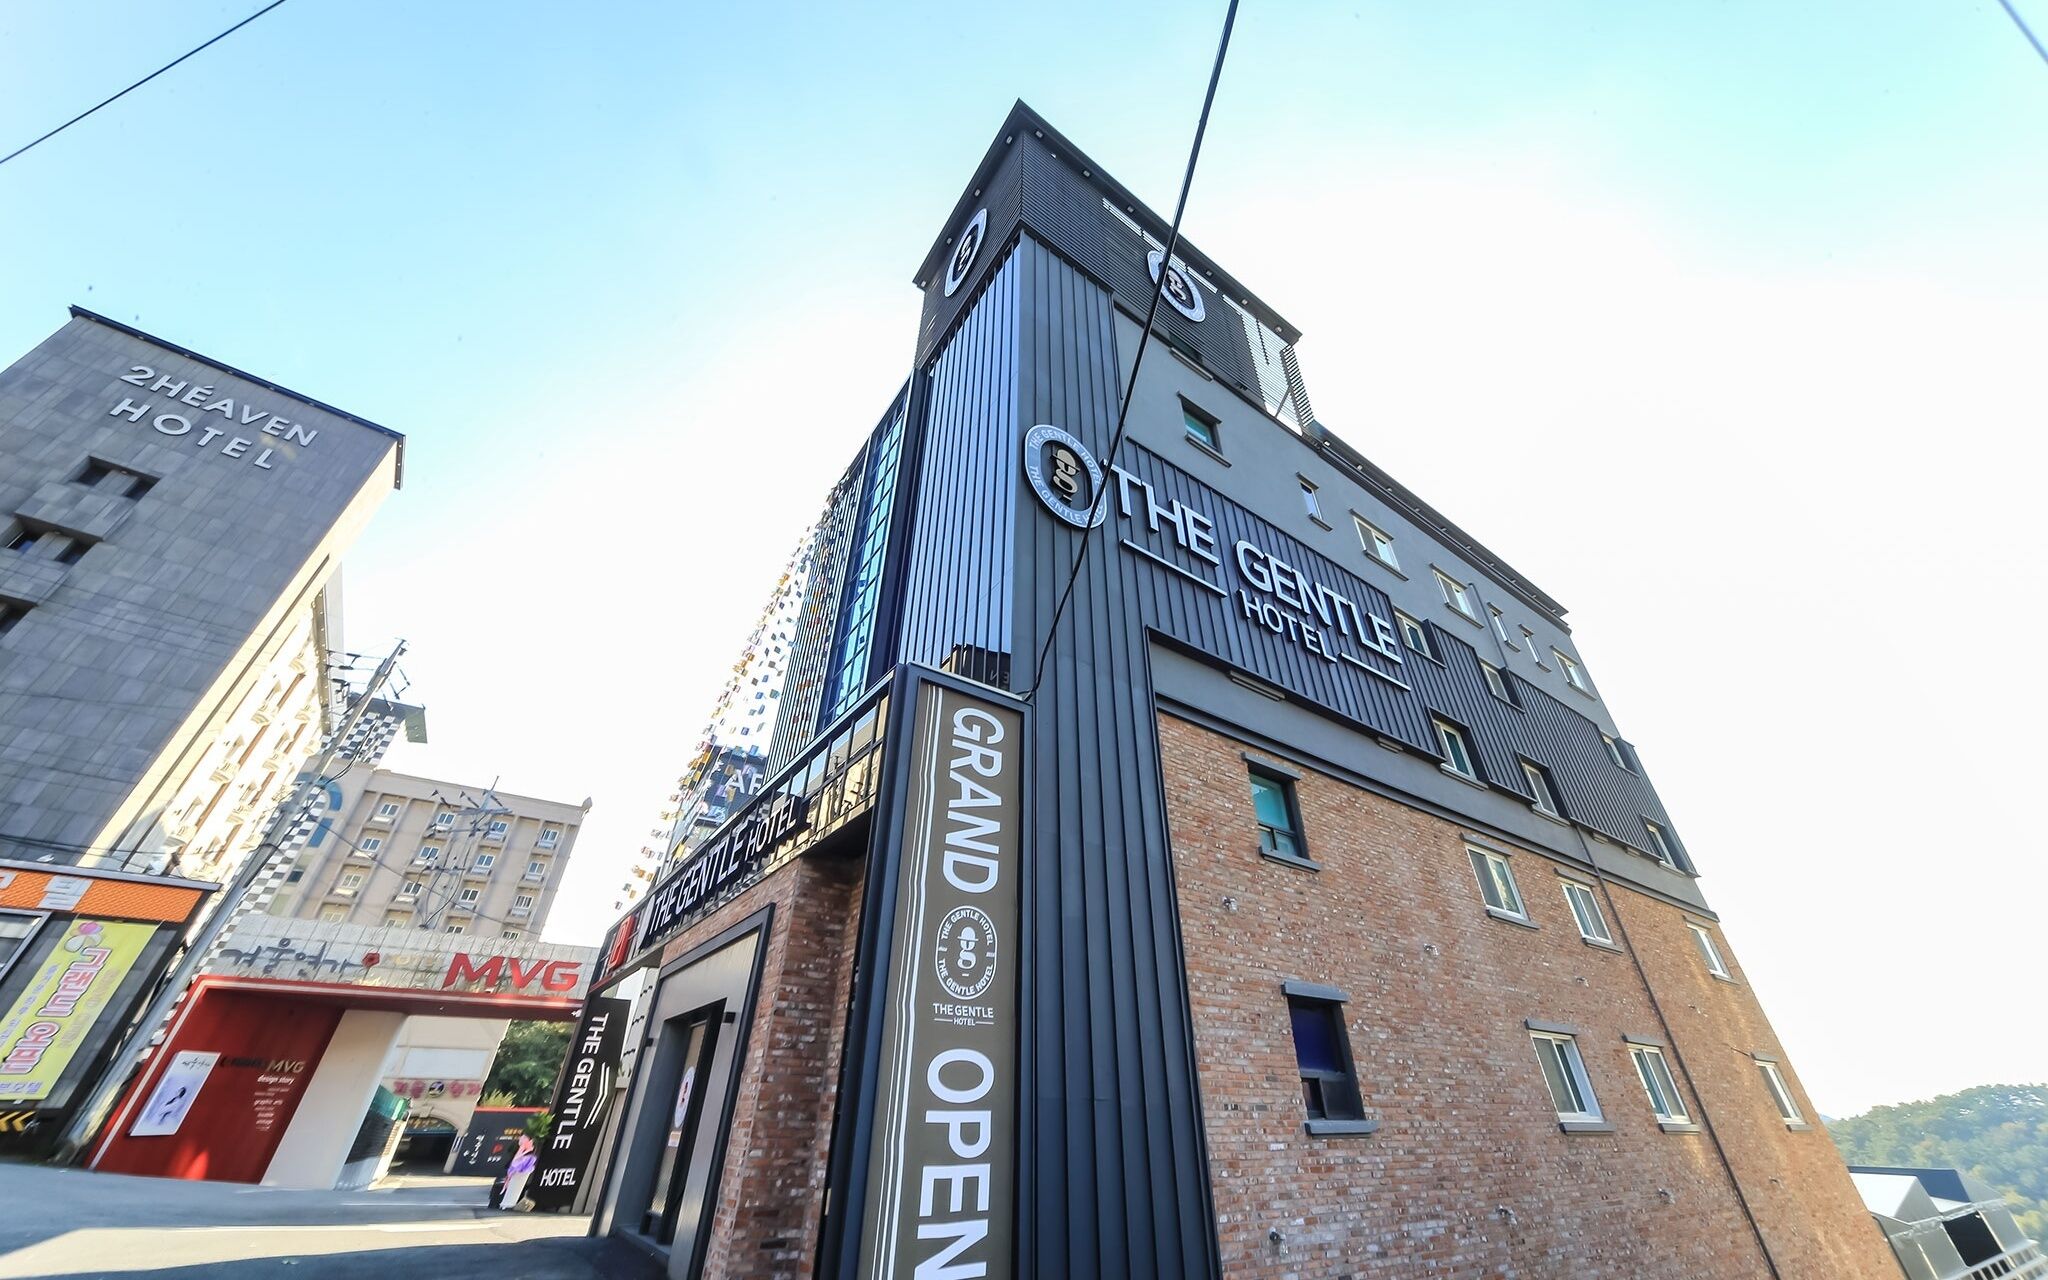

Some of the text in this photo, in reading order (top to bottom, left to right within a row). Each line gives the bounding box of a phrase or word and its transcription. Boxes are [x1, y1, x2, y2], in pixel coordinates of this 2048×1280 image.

[109, 398, 274, 470] HOTEL
[119, 365, 319, 447] 2HÉAVEN
[1029, 431, 1044, 450] THE
[1042, 429, 1080, 452] GENTLE
[1029, 466, 1104, 524] THE GENTLE HTEL
[1102, 459, 1403, 665] THE GENTLE
[1238, 588, 1338, 663] HOTEL
[943, 707, 1005, 894] GRAND
[649, 796, 796, 935] THE GENTLE HOTEL
[941, 909, 994, 946] THE GENTLE HOTEL
[36, 948, 112, 1017] 그랜드
[442, 952, 582, 992] MVG
[938, 959, 994, 996] THE GENTLE HOTEL
[932, 1003, 994, 1018] THE GENTLE
[953, 1017, 976, 1026] HOTEL
[0, 1021, 61, 1074] 오픈
[266, 1058, 306, 1074] MVG
[552, 1012, 610, 1150] THE GENTLE
[539, 1167, 577, 1187] HOTEL
[914, 1048, 995, 1280] OPEN
